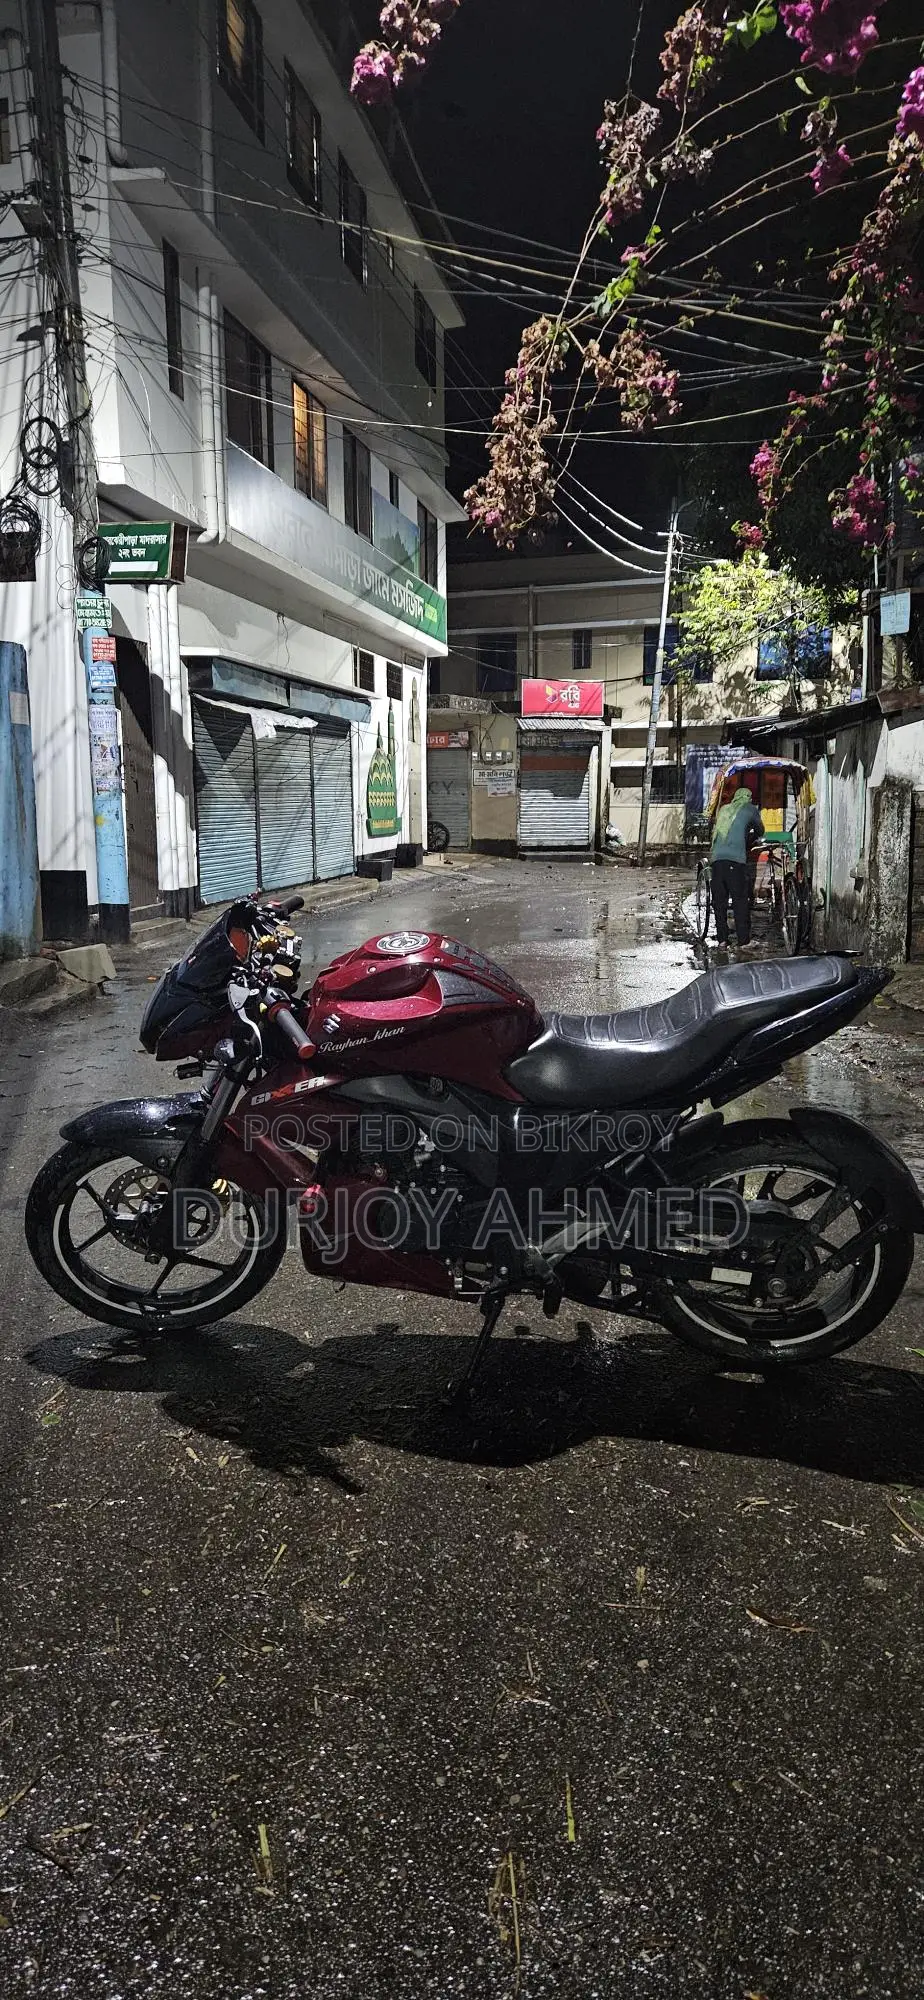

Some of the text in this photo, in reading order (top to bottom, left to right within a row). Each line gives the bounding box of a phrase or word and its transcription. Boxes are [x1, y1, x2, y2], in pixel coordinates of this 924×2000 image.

[131, 548, 146, 558] ভবন
[363, 560, 390, 602] জামে
[391, 578, 425, 622] মসজিদ
[559, 685, 581, 703] রবি
